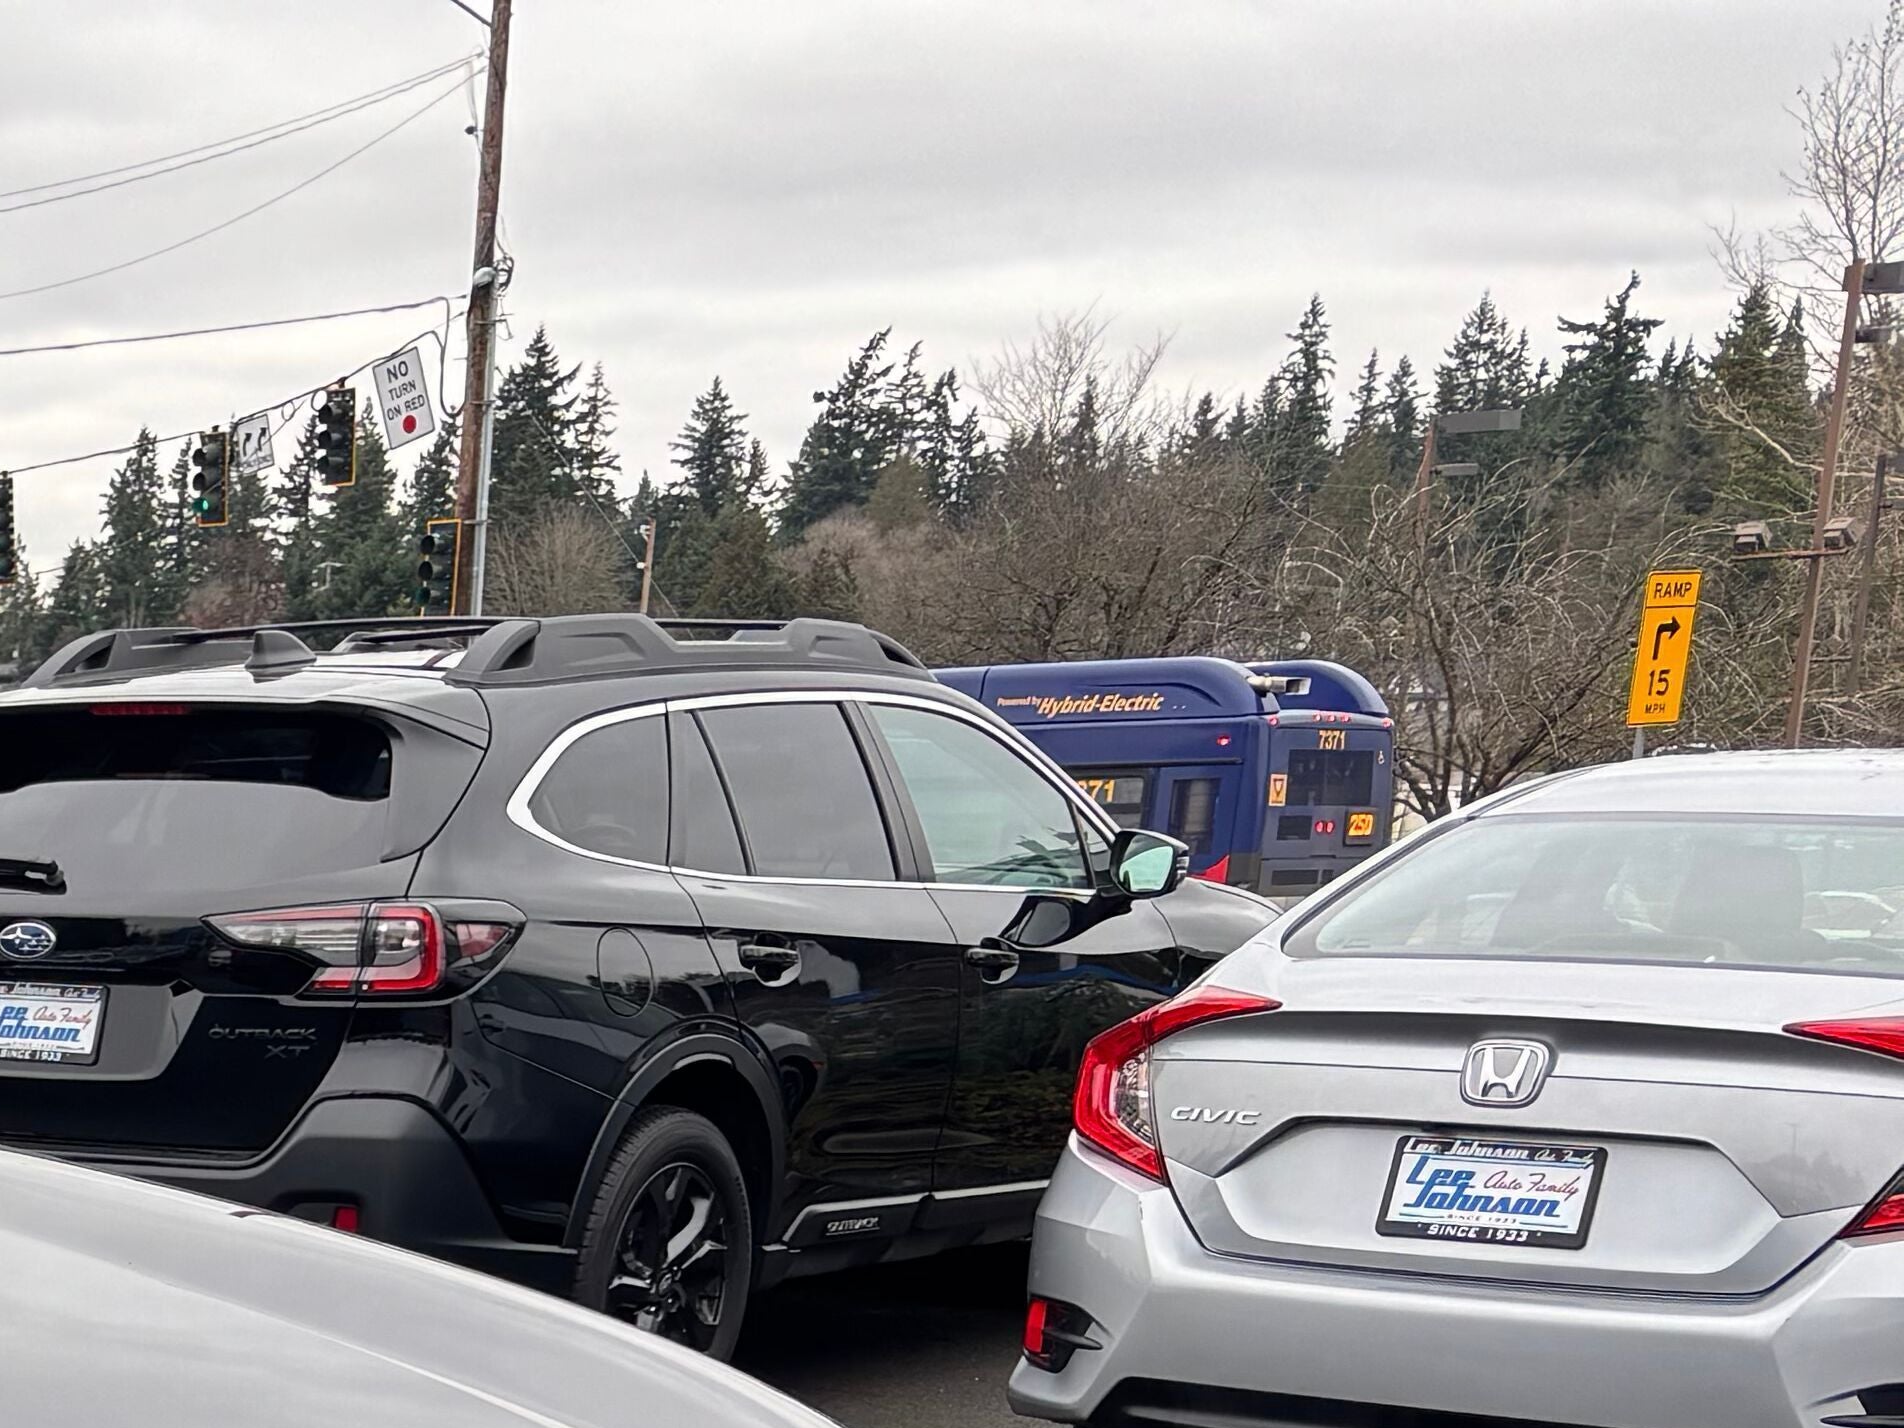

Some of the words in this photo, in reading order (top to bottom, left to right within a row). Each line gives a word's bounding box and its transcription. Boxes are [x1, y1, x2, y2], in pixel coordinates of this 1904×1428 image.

[386, 361, 409, 383] NO
[388, 380, 417, 401] TURN
[387, 405, 402, 421] ON
[404, 394, 425, 412] RED
[1654, 582, 1692, 599] RAMP
[1648, 669, 1671, 696] 15
[1037, 692, 1164, 718] Hybrid-Electric
[1645, 703, 1666, 714] MPH
[1319, 730, 1346, 750] 7371
[33, 1006, 56, 1021] Auto
[60, 1007, 92, 1030] Family
[208, 1028, 317, 1040] OUTBACK
[264, 1045, 311, 1058] XT
[1170, 1105, 1261, 1125] CIVIC
[1403, 1137, 1440, 1154] Lee
[1444, 1139, 1530, 1160] Johnson
[1406, 1156, 1476, 1187] Lee
[1483, 1170, 1523, 1190] Auto
[1526, 1173, 1580, 1202] Family
[1403, 1181, 1561, 1218] Johnson
[1427, 1226, 1479, 1239] SINCE
[1486, 1228, 1529, 1242] 1933
